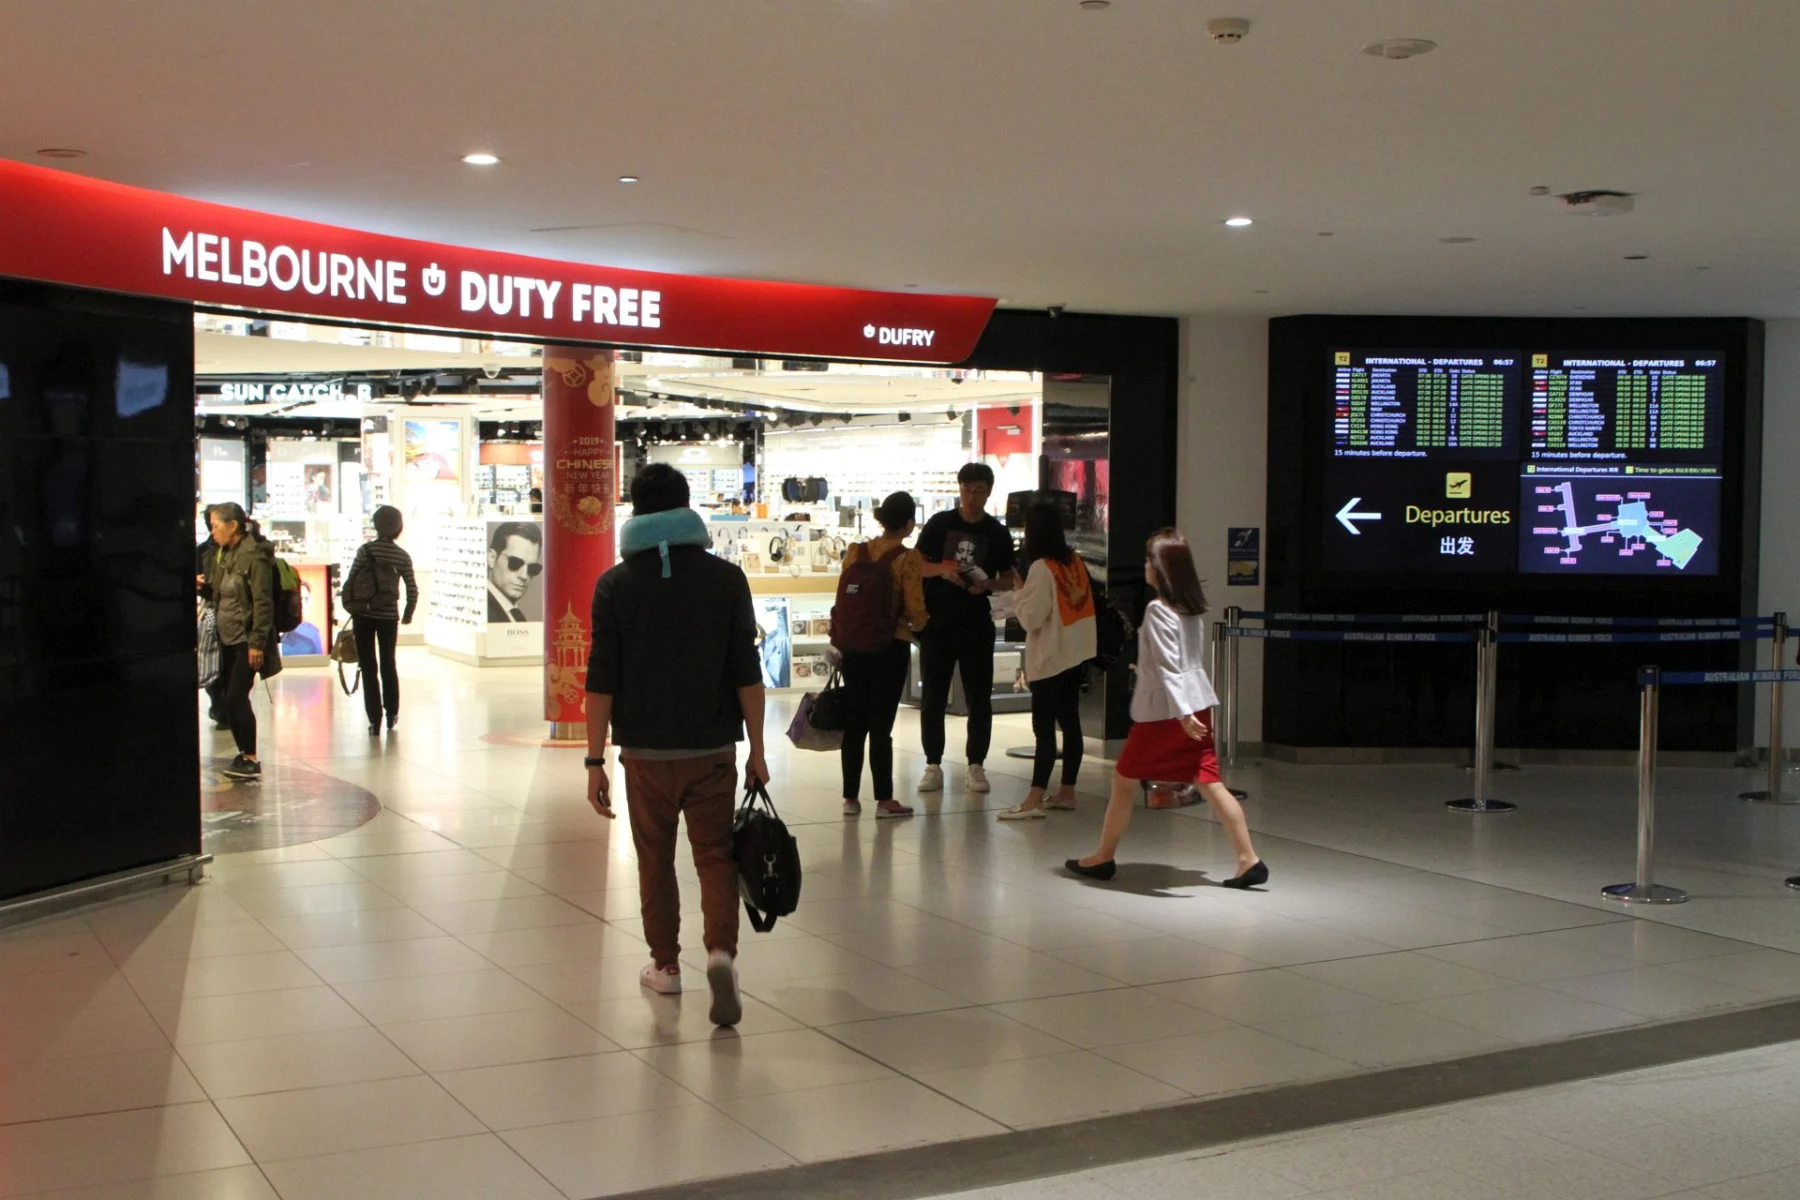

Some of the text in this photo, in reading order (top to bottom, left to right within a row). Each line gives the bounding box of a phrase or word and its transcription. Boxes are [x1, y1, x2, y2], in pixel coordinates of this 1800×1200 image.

[162, 226, 660, 328] MELBOURNE DUTY FREE
[879, 327, 935, 347] DUFRY
[220, 383, 372, 401] SUN CATCHR
[578, 437, 599, 445] 2019
[574, 448, 604, 456] HAPPY
[1405, 505, 1511, 527] Departures
[1440, 536, 1474, 555] 出发
[1274, 613, 1310, 621] AUSTRALIAN
[1534, 616, 1569, 624] AUSTRALIAN
[1343, 632, 1384, 641] AUSTRALIAN
[1529, 634, 1566, 642] AUSTRALIAN
[1660, 632, 1696, 641] AUSTRALIAN
[1704, 672, 1750, 682] AUSTRALIAN
